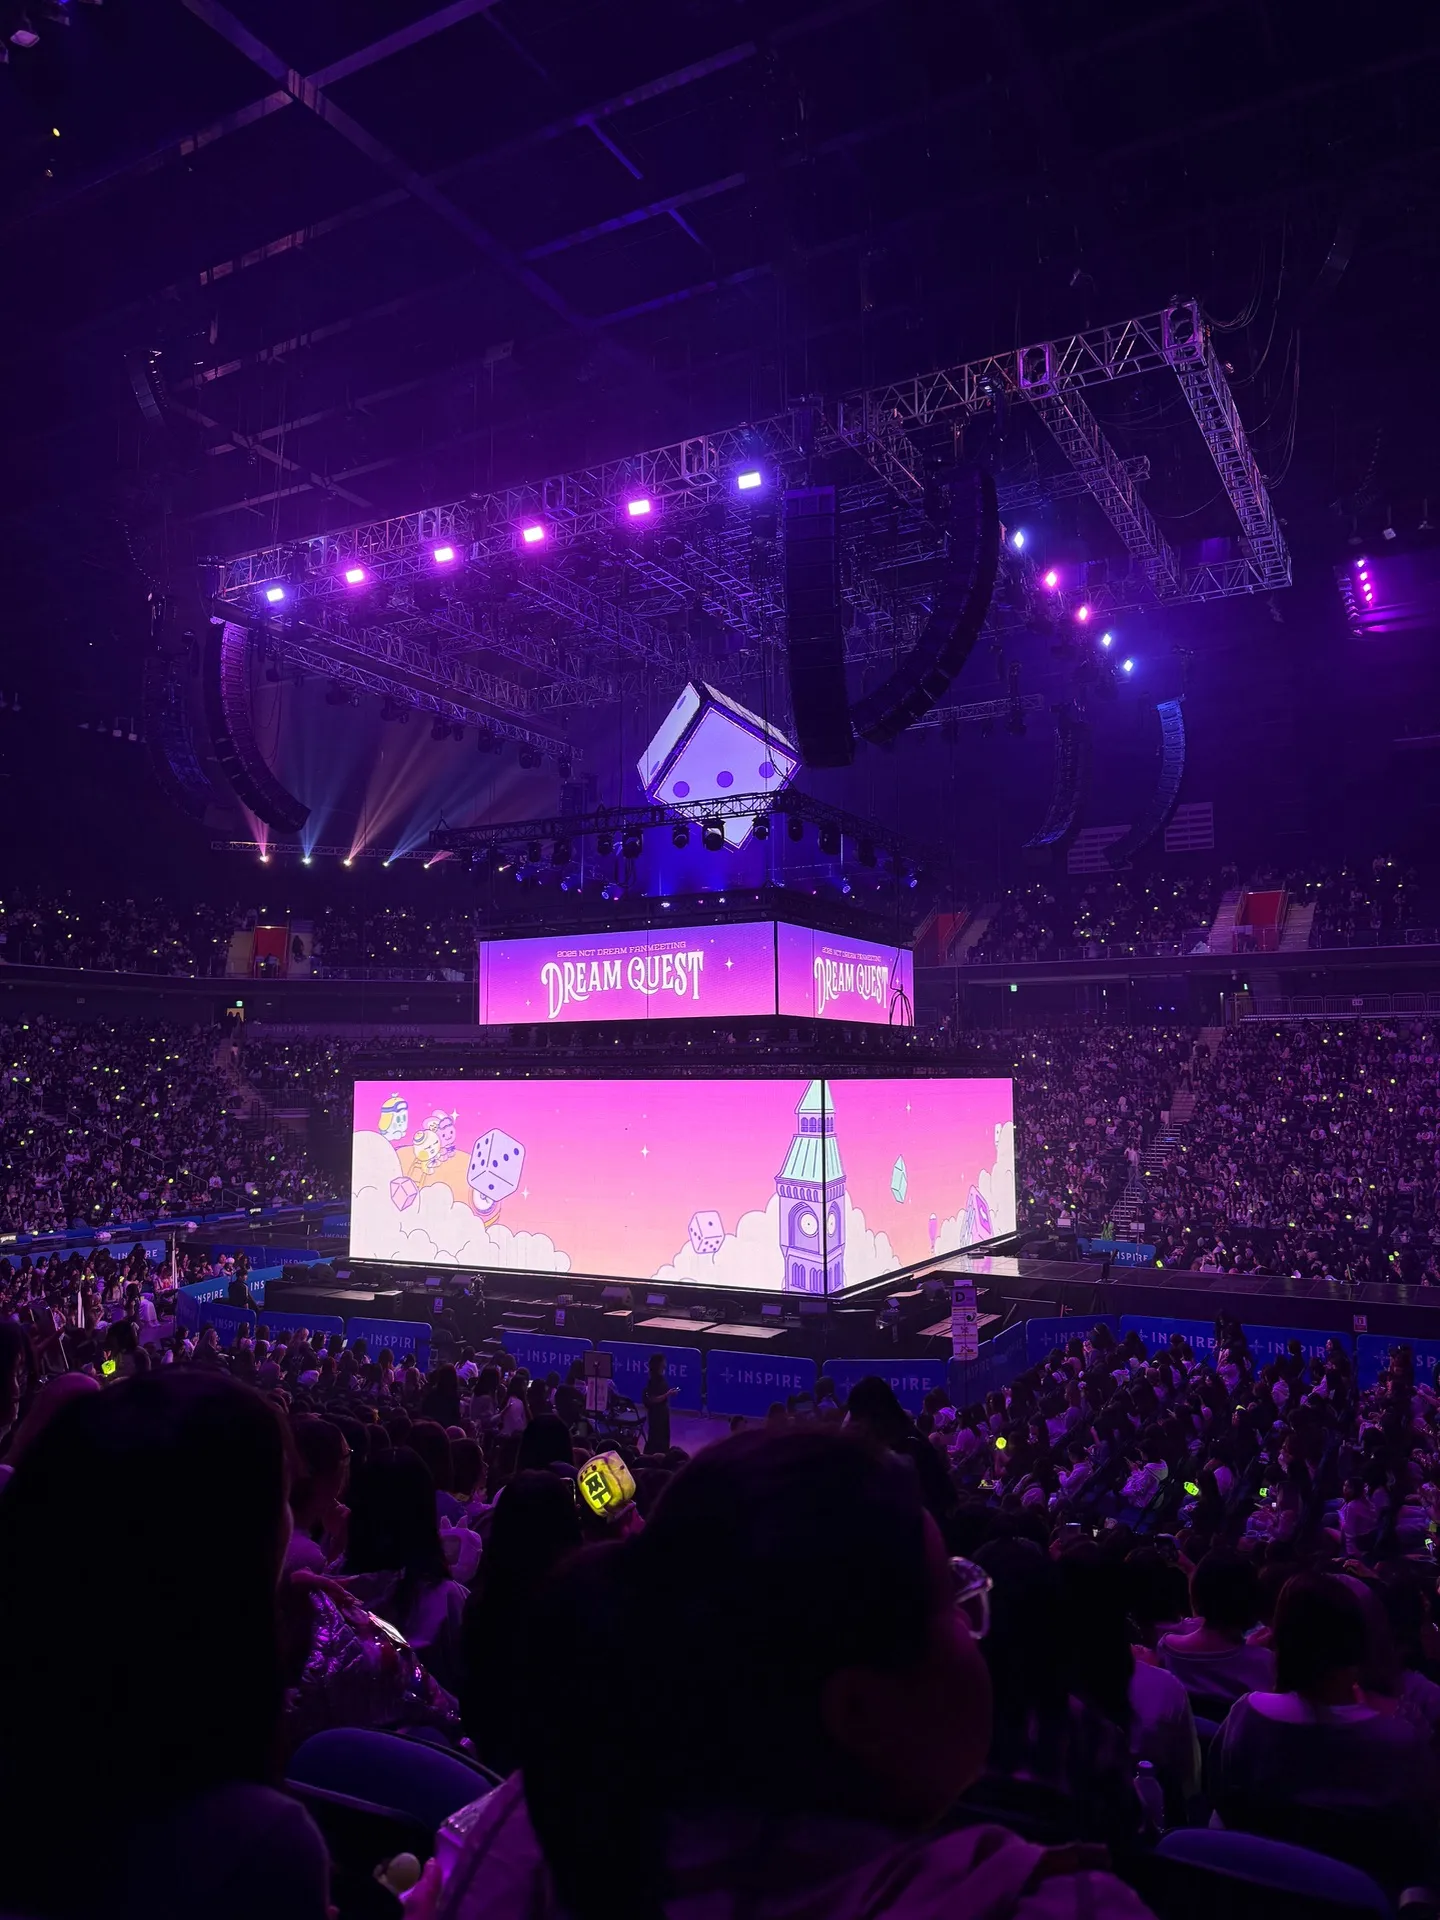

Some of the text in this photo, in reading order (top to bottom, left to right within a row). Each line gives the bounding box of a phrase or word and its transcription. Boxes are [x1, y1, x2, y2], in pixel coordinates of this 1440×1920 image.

[557, 941, 686, 958] 2025 NCT DREAM FANMEETING
[540, 951, 704, 1019] DREAM QUEST
[814, 956, 888, 1015] DREAM QUEST
[117, 1249, 158, 1261] INRE
[1110, 1251, 1148, 1262] NSPIRE
[195, 1288, 224, 1304] NSPIRE
[626, 1357, 688, 1378] INSRE
[737, 1369, 802, 1389] INSPIRE
[890, 1377, 932, 1391] PIRE
